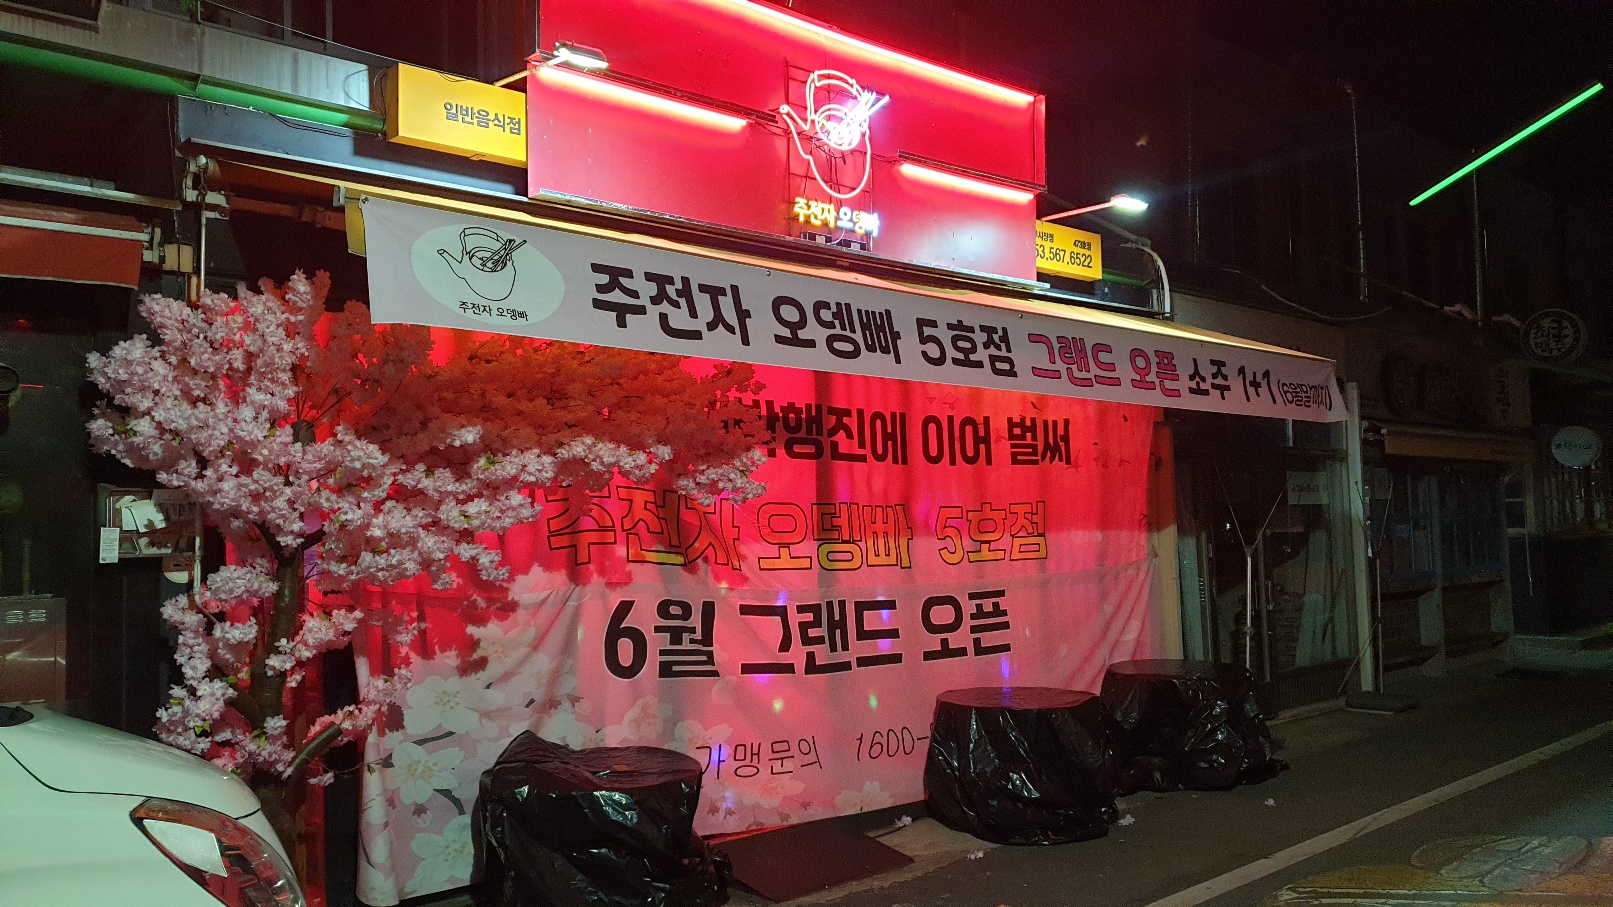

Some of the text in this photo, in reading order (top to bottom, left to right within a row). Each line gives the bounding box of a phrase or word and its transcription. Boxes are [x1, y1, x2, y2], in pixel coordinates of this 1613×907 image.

[443, 101, 522, 136] 일반음식점
[793, 197, 836, 229] 주전자
[458, 300, 529, 322] 주전자 오뎅빠
[590, 262, 752, 344] 주전자
[771, 295, 902, 365] 오뎅빠
[916, 317, 1018, 379] 5호점
[1028, 333, 1122, 388] 그랜드
[1130, 347, 1182, 398] 오픈
[1187, 358, 1231, 401] 소주
[1238, 366, 1277, 405] 1+1
[921, 414, 993, 467] 이어
[1008, 415, 1073, 467] 벌써
[545, 484, 1048, 572] 주전자 오뎅빠 5호점
[604, 588, 1012, 680] 6월 그랜드 오픈
[696, 722, 934, 780] 가맹문의 1600-
